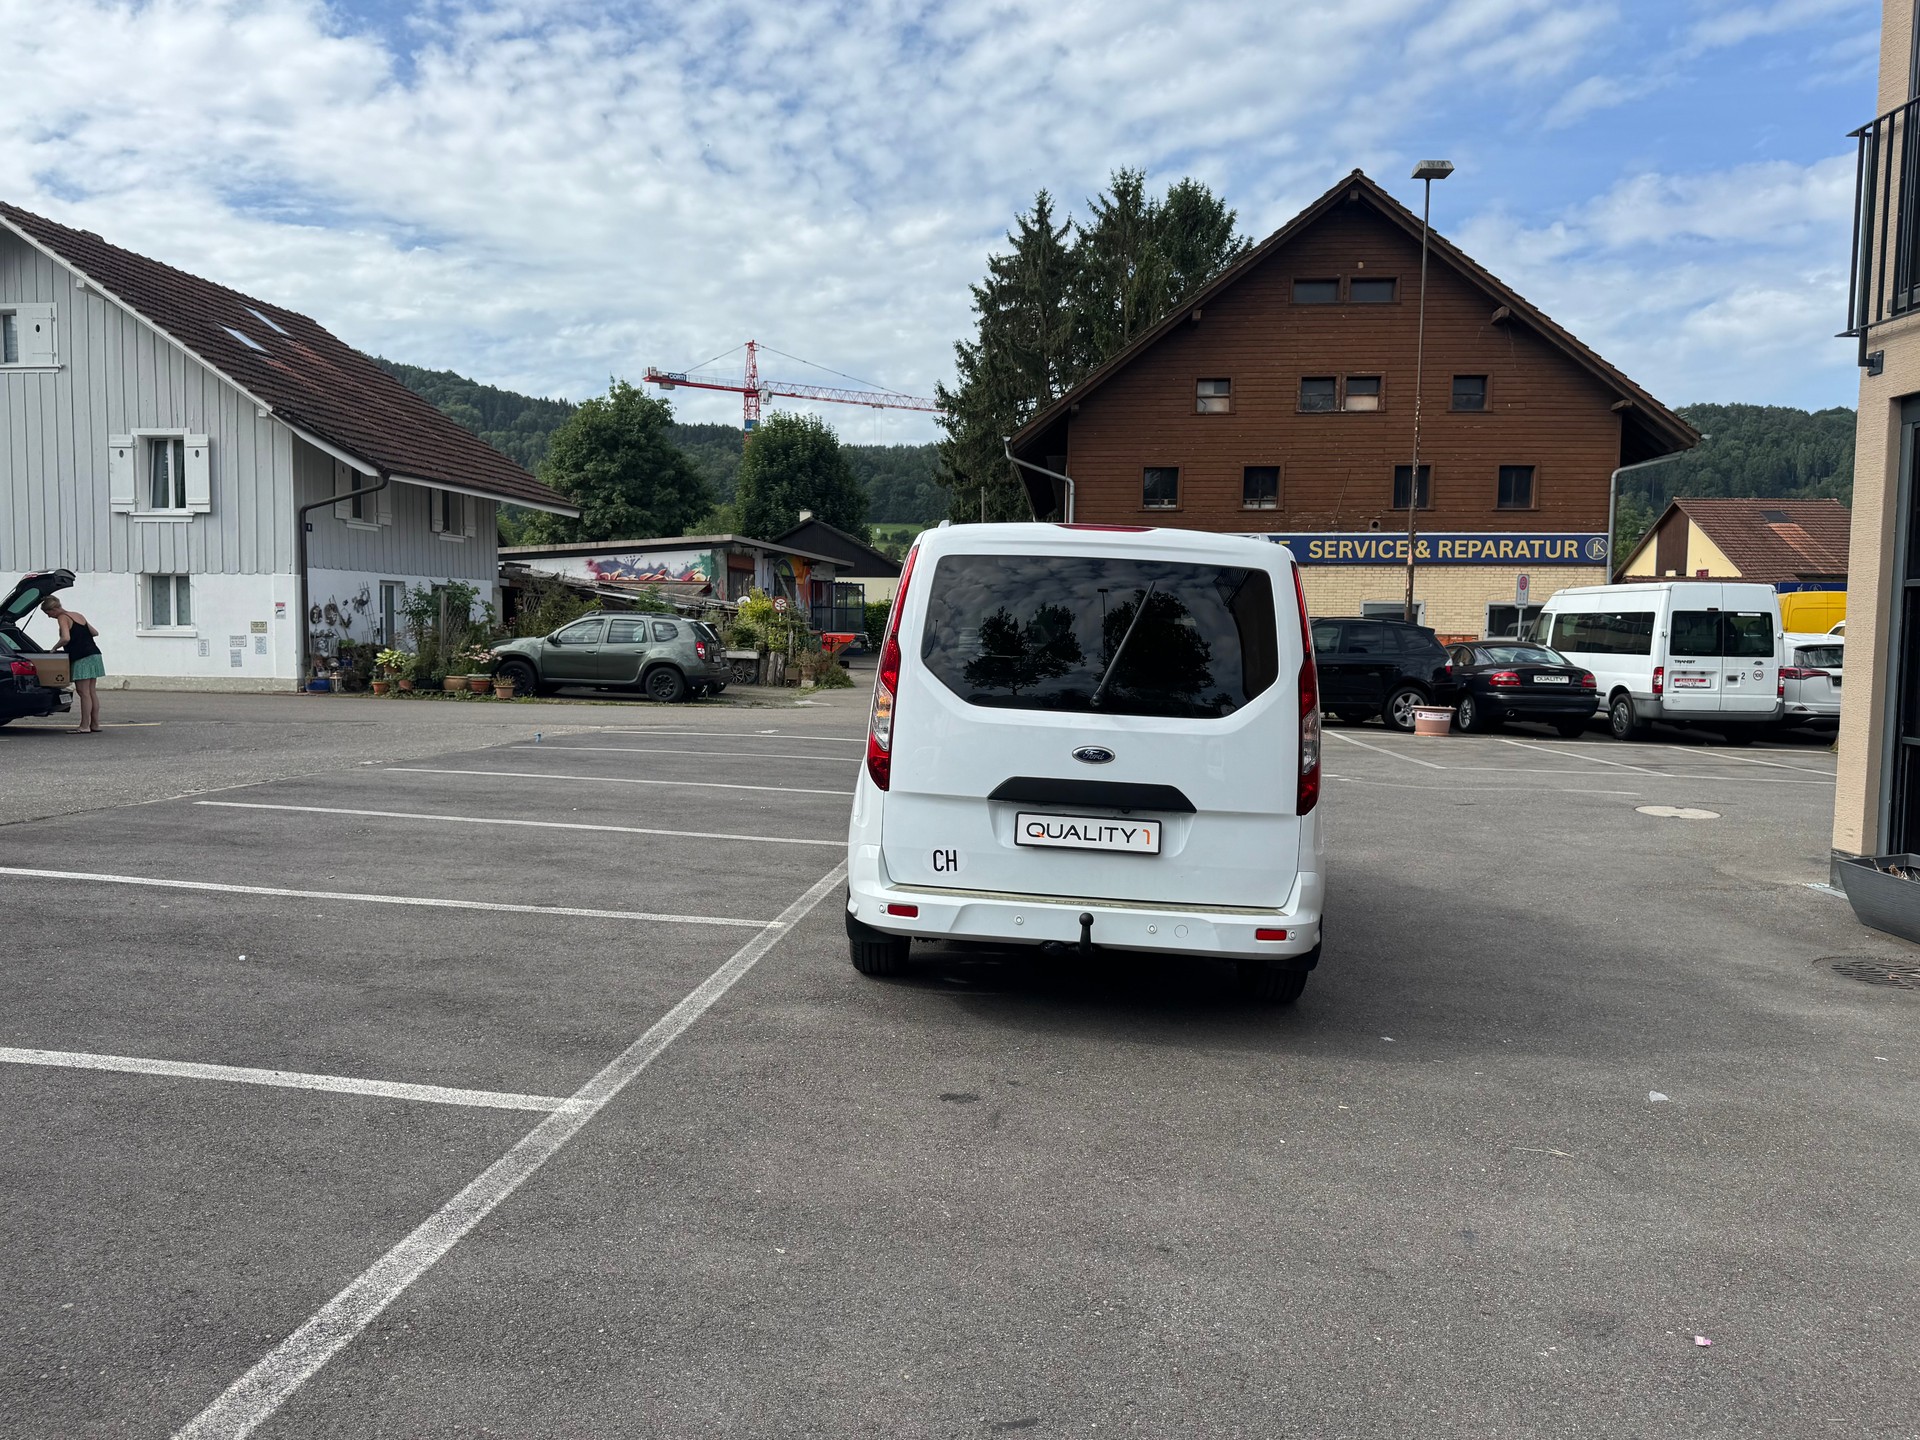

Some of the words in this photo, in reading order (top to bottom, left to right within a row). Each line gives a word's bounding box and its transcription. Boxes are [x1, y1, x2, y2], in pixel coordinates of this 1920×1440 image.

[1309, 540, 1408, 559] SERVICE
[1414, 540, 1431, 559] &
[1438, 540, 1579, 559] REPARATUR
[1082, 749, 1106, 760] Ford
[1026, 822, 1137, 844] QUALITY
[1143, 829, 1150, 845] 1
[932, 849, 958, 872] CH
